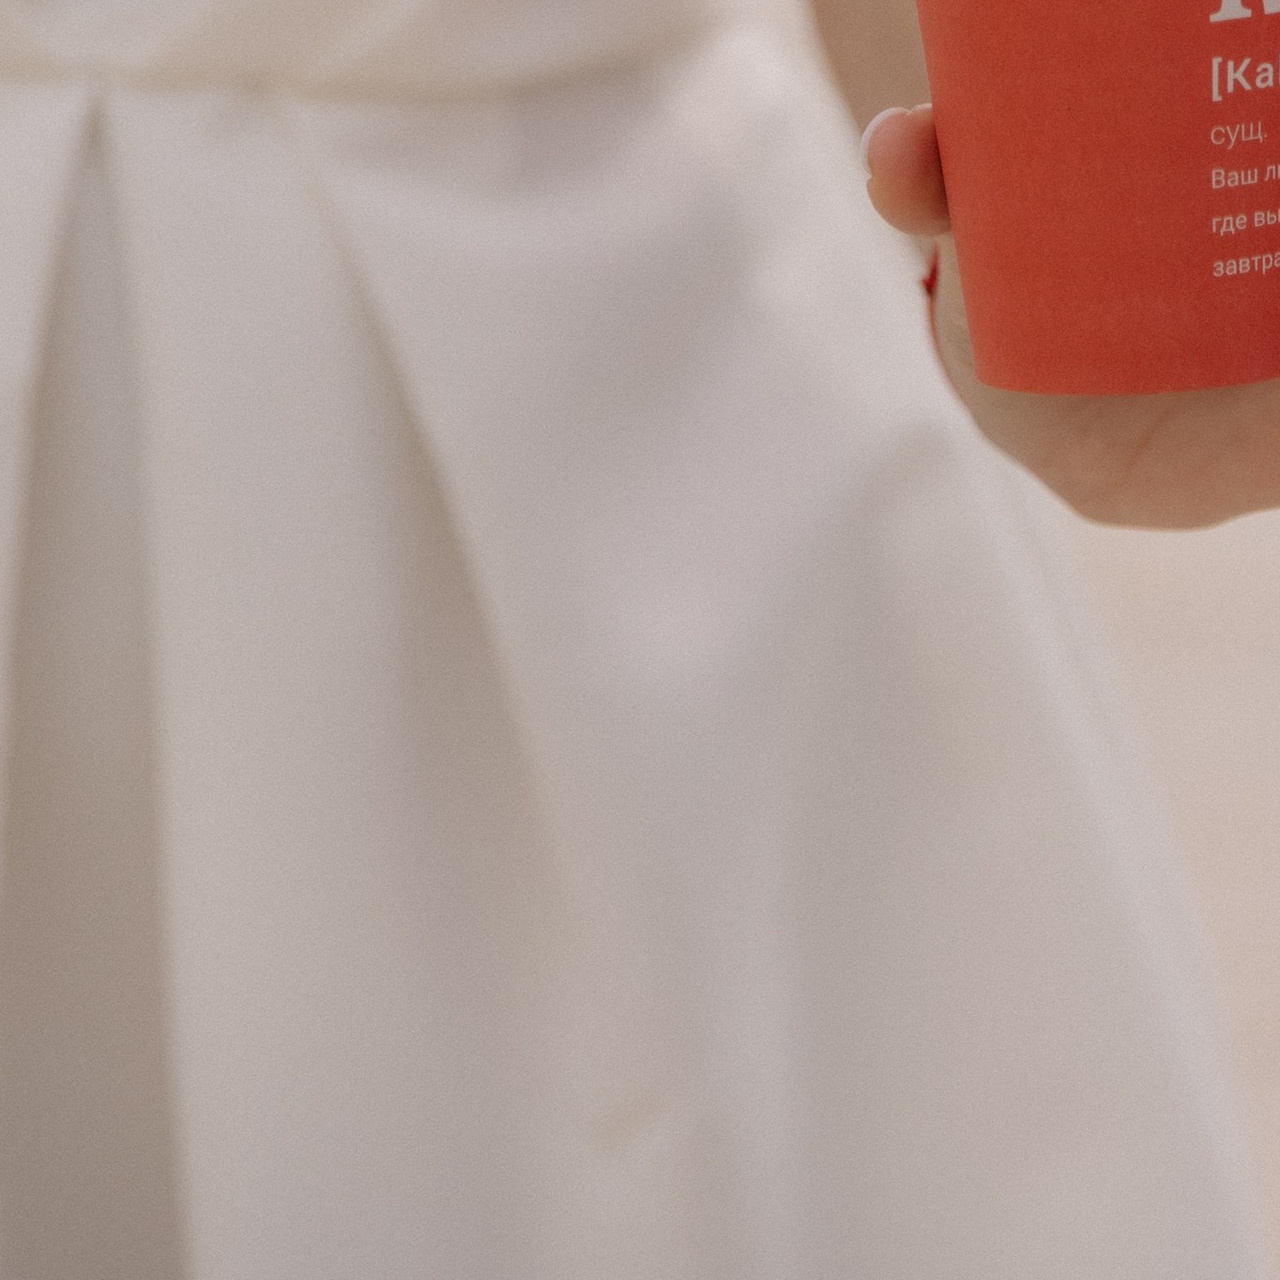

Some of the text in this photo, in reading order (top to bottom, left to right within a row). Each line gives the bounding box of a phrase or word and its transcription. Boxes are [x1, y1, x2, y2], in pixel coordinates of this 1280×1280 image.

[1210, 121, 1268, 150] сущ.
[1211, 168, 1258, 189] Ваш
[1211, 214, 1247, 236] где
[1254, 208, 1280, 228] вы
